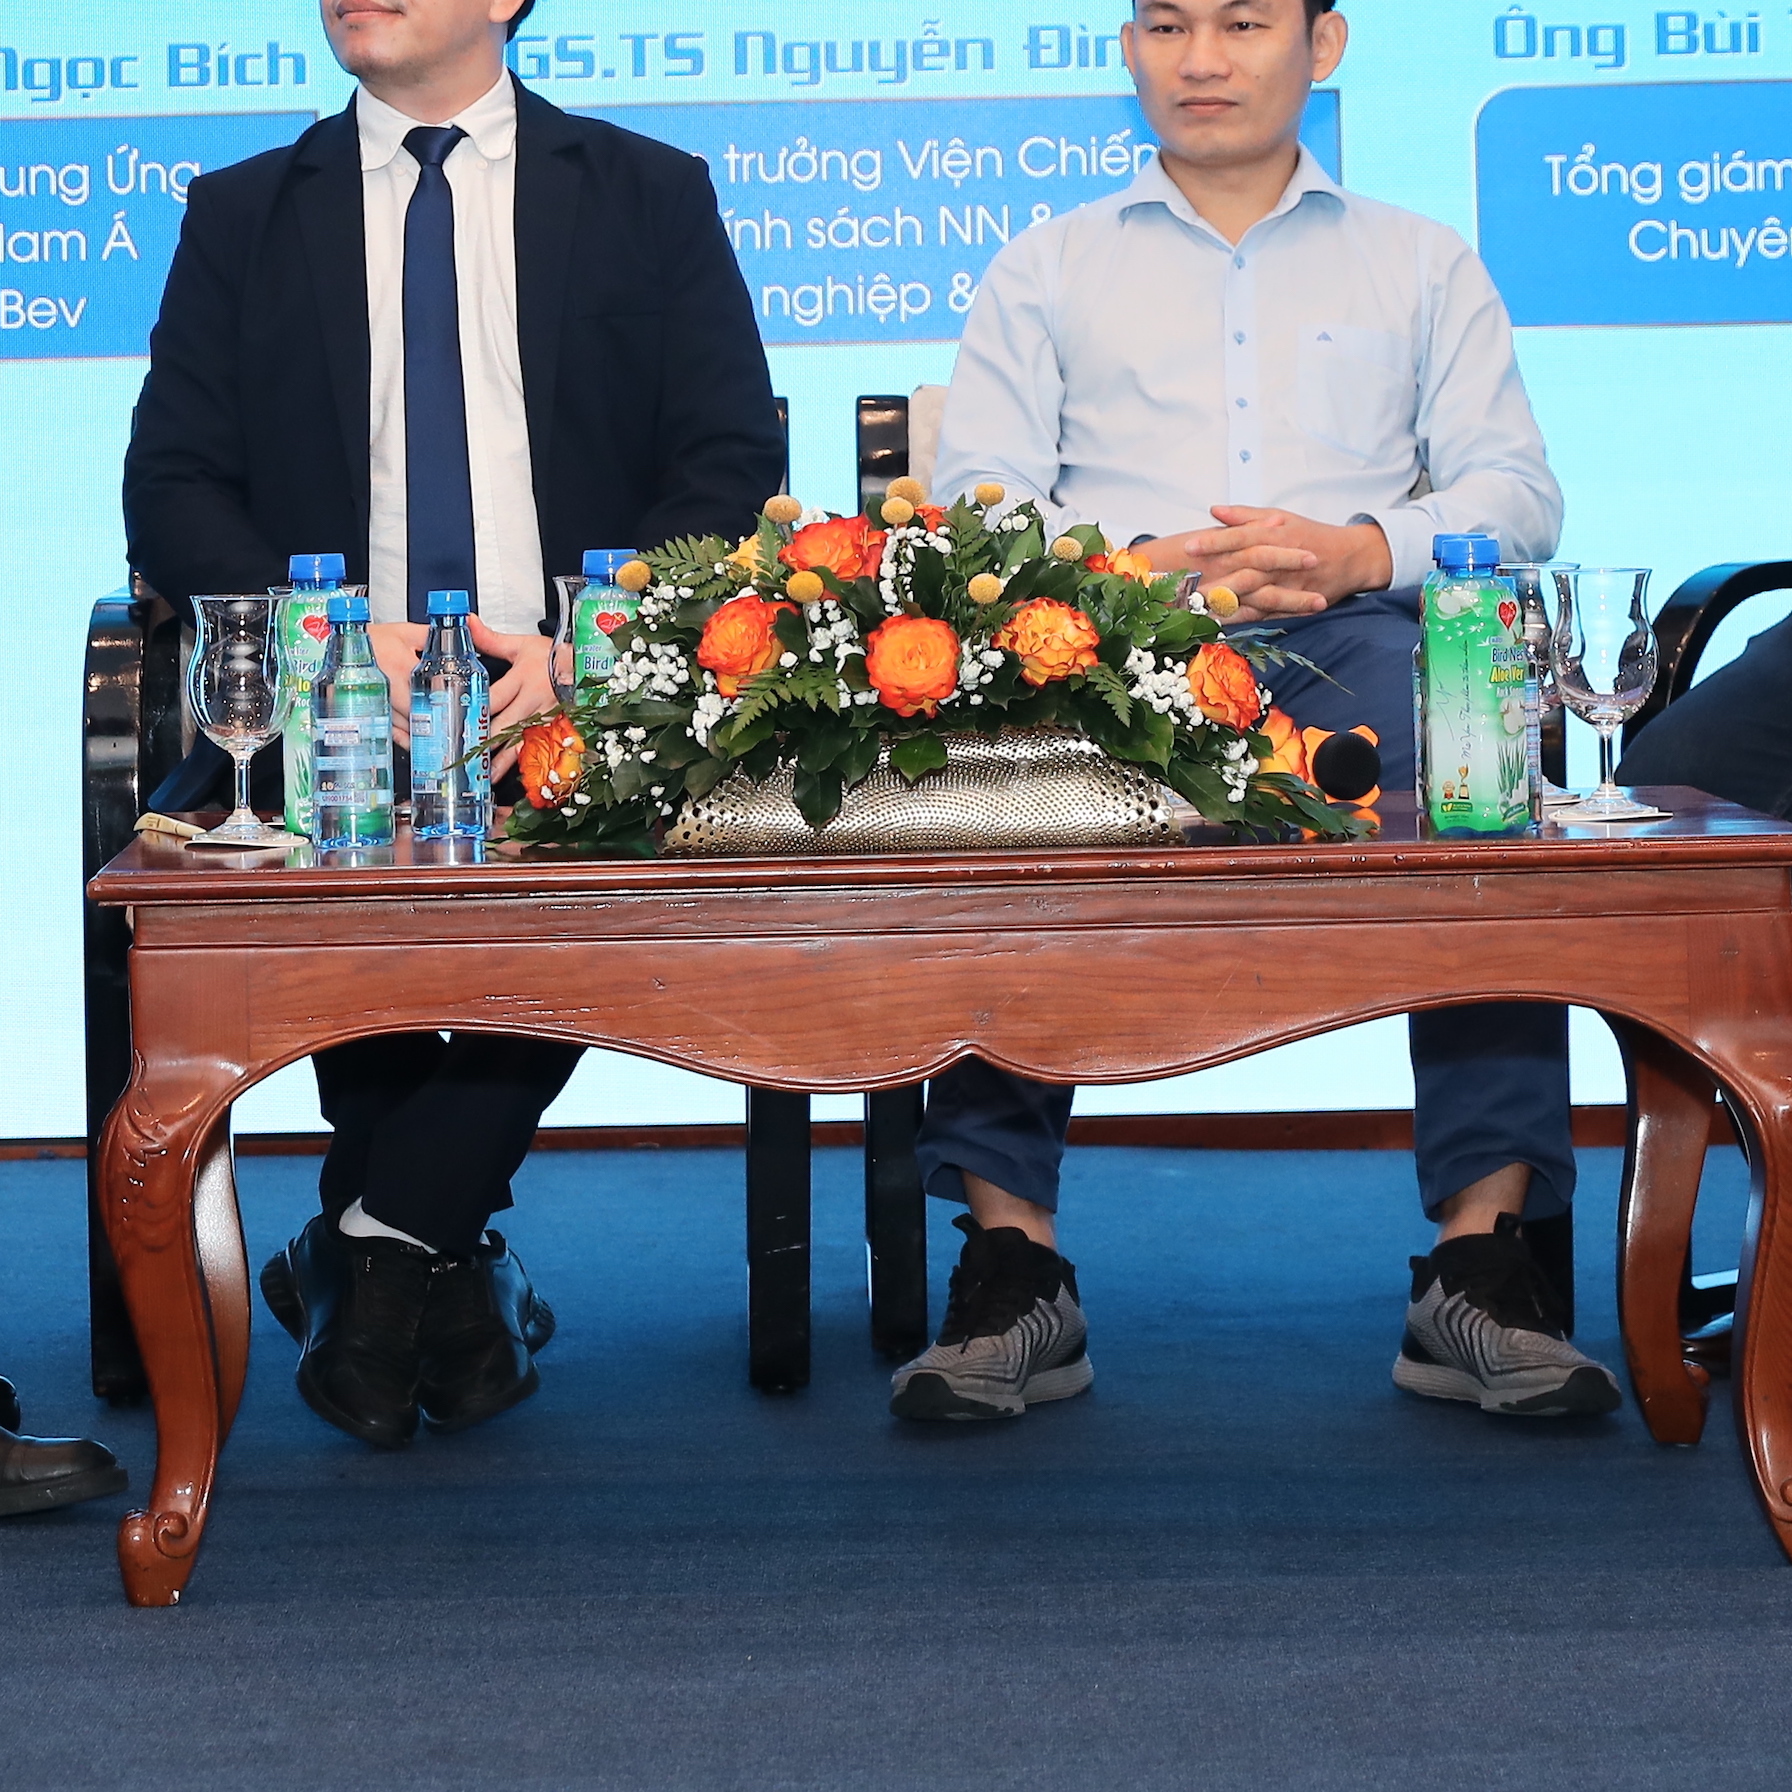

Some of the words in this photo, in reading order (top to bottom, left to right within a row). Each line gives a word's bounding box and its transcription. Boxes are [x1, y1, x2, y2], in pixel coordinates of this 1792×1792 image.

[167, 40, 307, 88] Bích
[734, 19, 994, 87] Nguyễn
[1023, 23, 1127, 70] Đìn
[1494, 4, 1626, 70] Ông
[1655, 9, 1761, 56] Bùi
[107, 143, 202, 204] Ứng
[723, 136, 881, 191] trưởng
[897, 137, 1003, 188] Viện
[1543, 143, 1663, 204] Tổng
[101, 210, 140, 262] Á
[807, 206, 923, 250] sách
[939, 204, 1009, 247] NN
[762, 271, 931, 327] nghiệp
[946, 271, 979, 313] &
[584, 655, 609, 670] Bird
